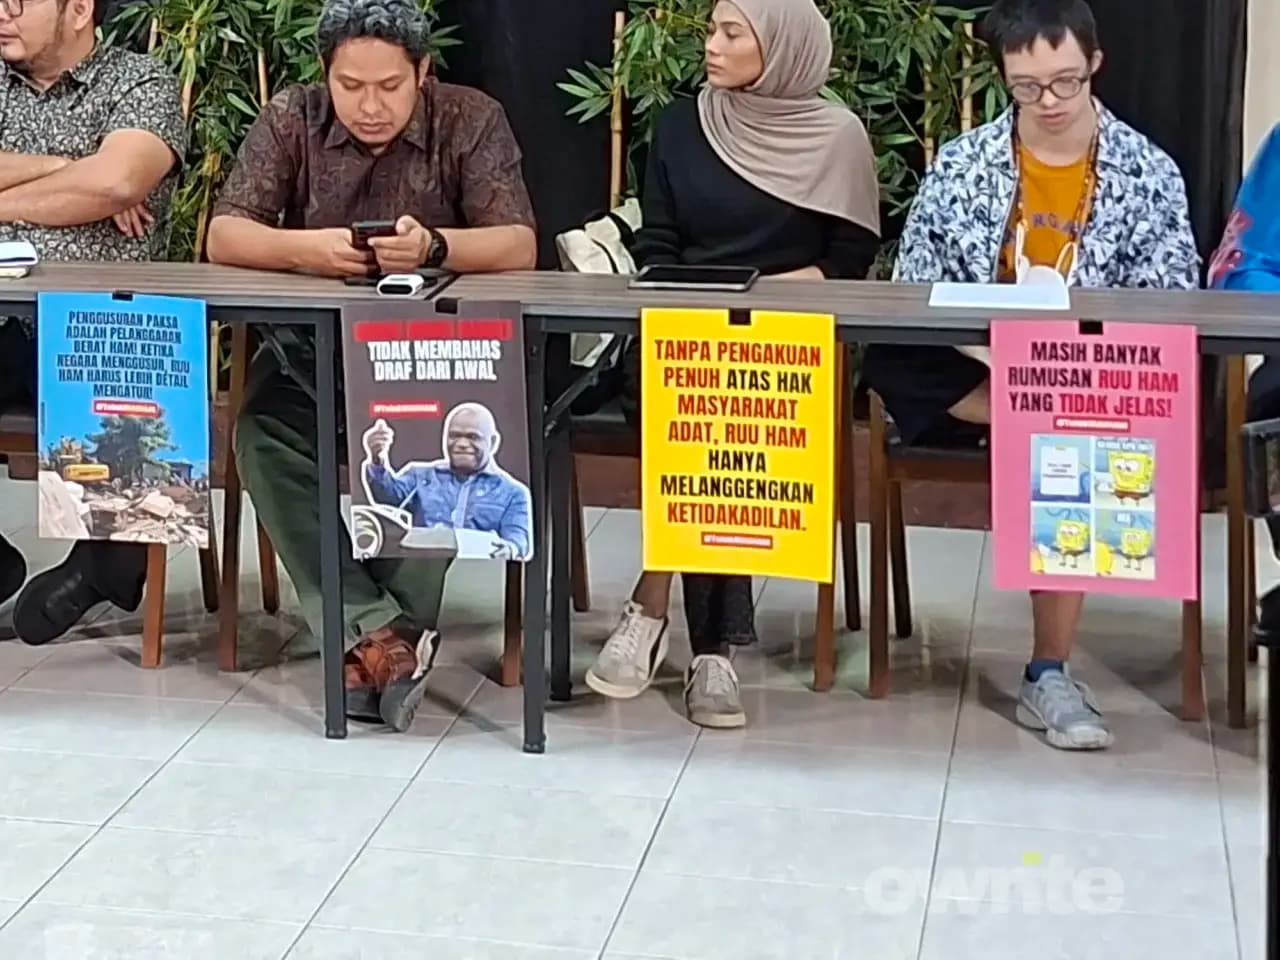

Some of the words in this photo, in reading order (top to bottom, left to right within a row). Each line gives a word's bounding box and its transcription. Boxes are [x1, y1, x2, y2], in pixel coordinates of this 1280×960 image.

[68, 311, 143, 326] PENGGUSURAN
[146, 314, 179, 329] PAKSA
[66, 326, 107, 339] ADALAH
[109, 328, 182, 343] PELANGGARAN
[73, 340, 106, 354] BERAT
[140, 344, 175, 357] KETIKA
[367, 340, 411, 361] TIDAK
[414, 339, 502, 359] MEMBAHAS
[654, 339, 712, 361] TANPA
[717, 341, 822, 367] PENGAKUAN
[1030, 341, 1088, 363] MASIH
[1093, 343, 1162, 366] BANYAK
[57, 354, 99, 367] NEGARA
[170, 359, 191, 373] RUU
[373, 360, 413, 381] DRAF
[415, 359, 451, 380] DARI
[58, 368, 84, 382] HAM
[87, 369, 121, 383] HARUS
[124, 371, 153, 385] LEBIH
[155, 372, 190, 388] DETAIL
[663, 366, 721, 389] PENUH
[726, 369, 771, 391] ATAS
[776, 371, 813, 395] HAK
[1007, 366, 1093, 389] RUMUSAN
[1098, 369, 1133, 391] RUU
[1138, 371, 1179, 394] HAM
[677, 394, 799, 421] MASYARAKAT
[1008, 391, 1054, 413] YANG
[1058, 393, 1110, 415] TIDAK
[1113, 395, 1173, 419] JELAS!
[667, 420, 719, 446] ADAT,
[724, 422, 760, 446] RUU
[765, 425, 807, 449] HAM
[708, 449, 767, 473] HANYA
[660, 474, 814, 504] MELANGGENGKAN
[667, 501, 807, 531] KETIDAKADILAN.
